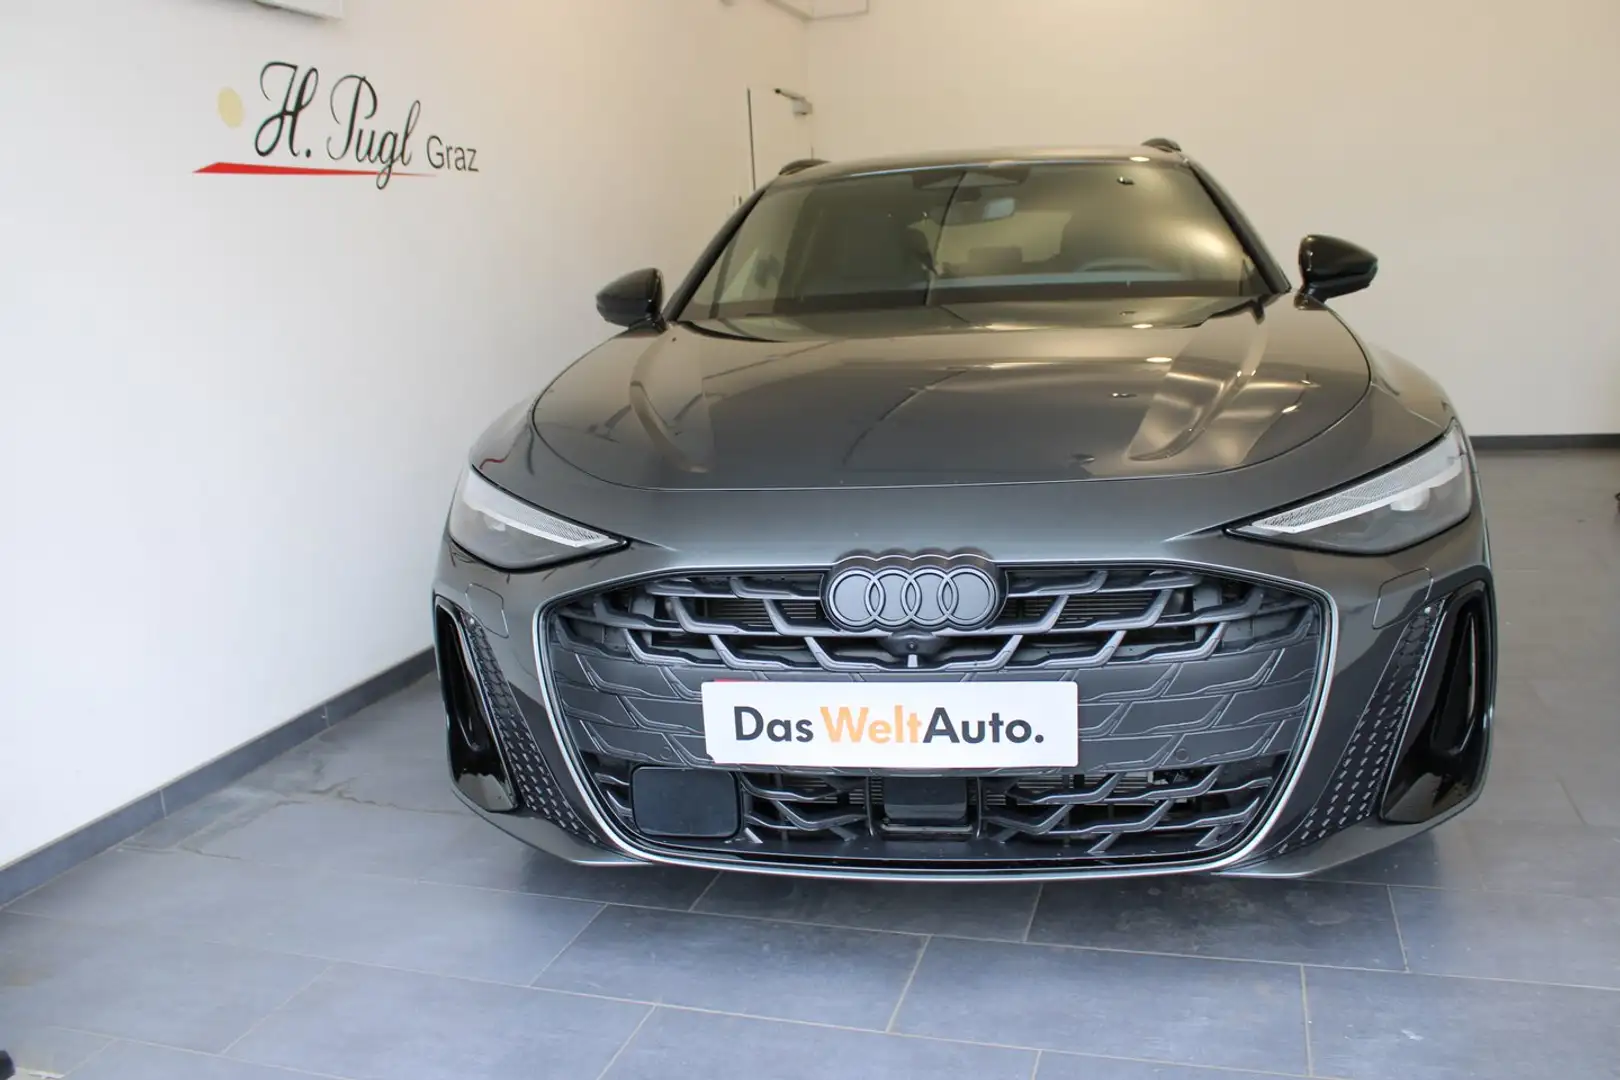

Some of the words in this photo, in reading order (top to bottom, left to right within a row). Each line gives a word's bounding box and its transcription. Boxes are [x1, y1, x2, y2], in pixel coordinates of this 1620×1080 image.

[254, 60, 319, 158] H.
[326, 74, 421, 190] Pugl
[426, 134, 479, 172] Graz
[733, 705, 813, 743] Das
[820, 704, 1045, 744] WeltAuto.
